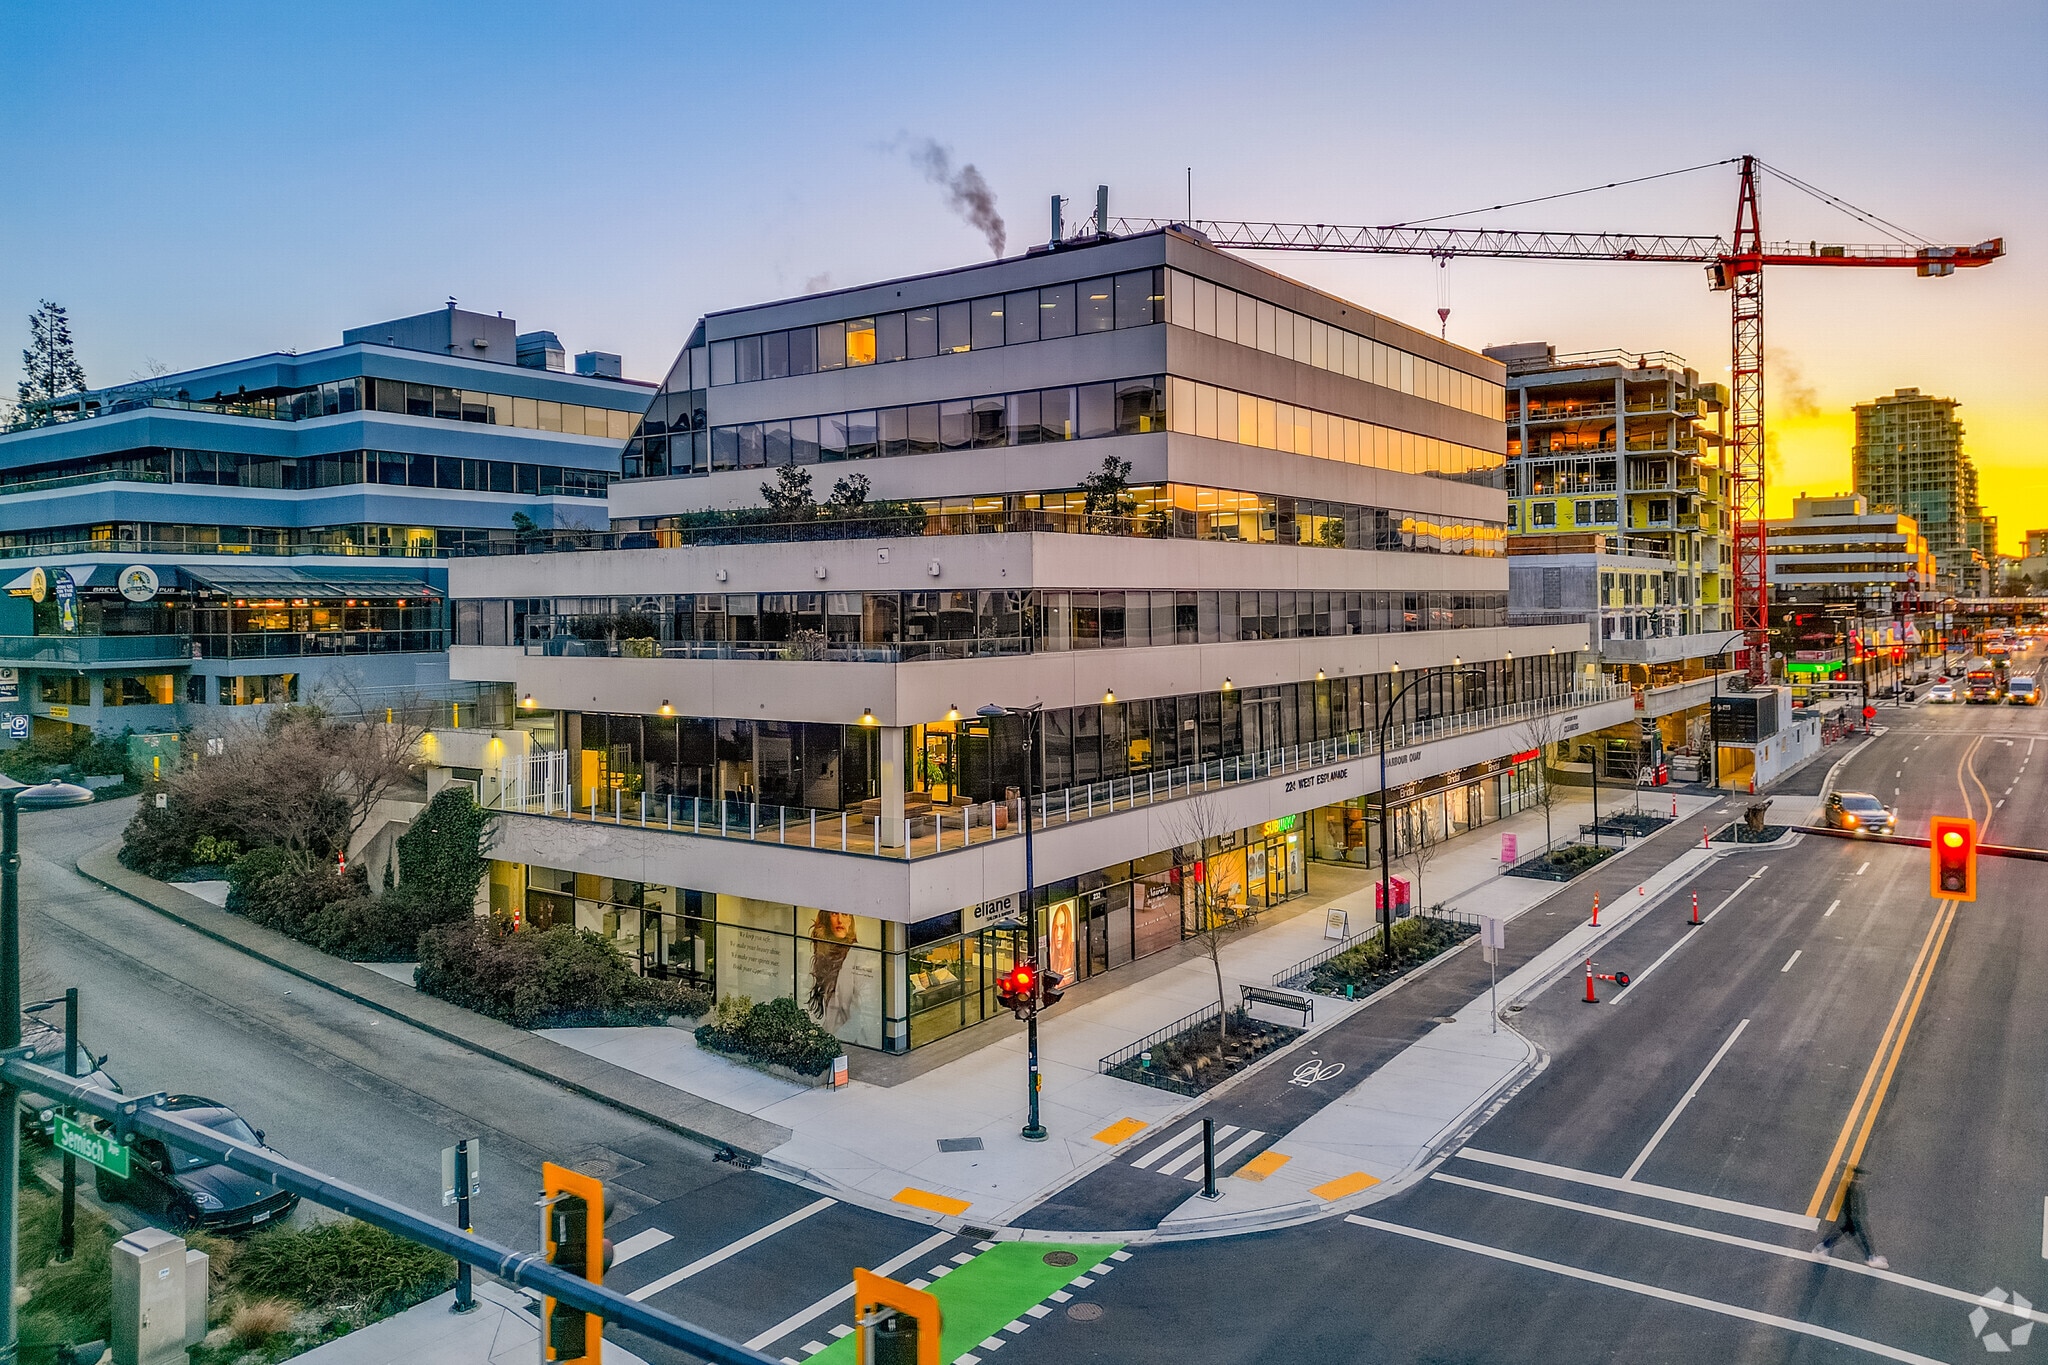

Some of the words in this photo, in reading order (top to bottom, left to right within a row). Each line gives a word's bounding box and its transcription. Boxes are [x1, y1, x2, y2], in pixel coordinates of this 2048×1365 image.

[15, 719, 24, 728] P
[1298, 776, 1315, 789] WEST
[1316, 768, 1348, 785] ESPLANADE
[1446, 774, 1461, 785] Bridal
[1400, 787, 1415, 799] Bridal
[1263, 814, 1296, 836] SUBWAY
[974, 897, 1011, 919] éliane
[61, 1122, 103, 1162] Semisch
